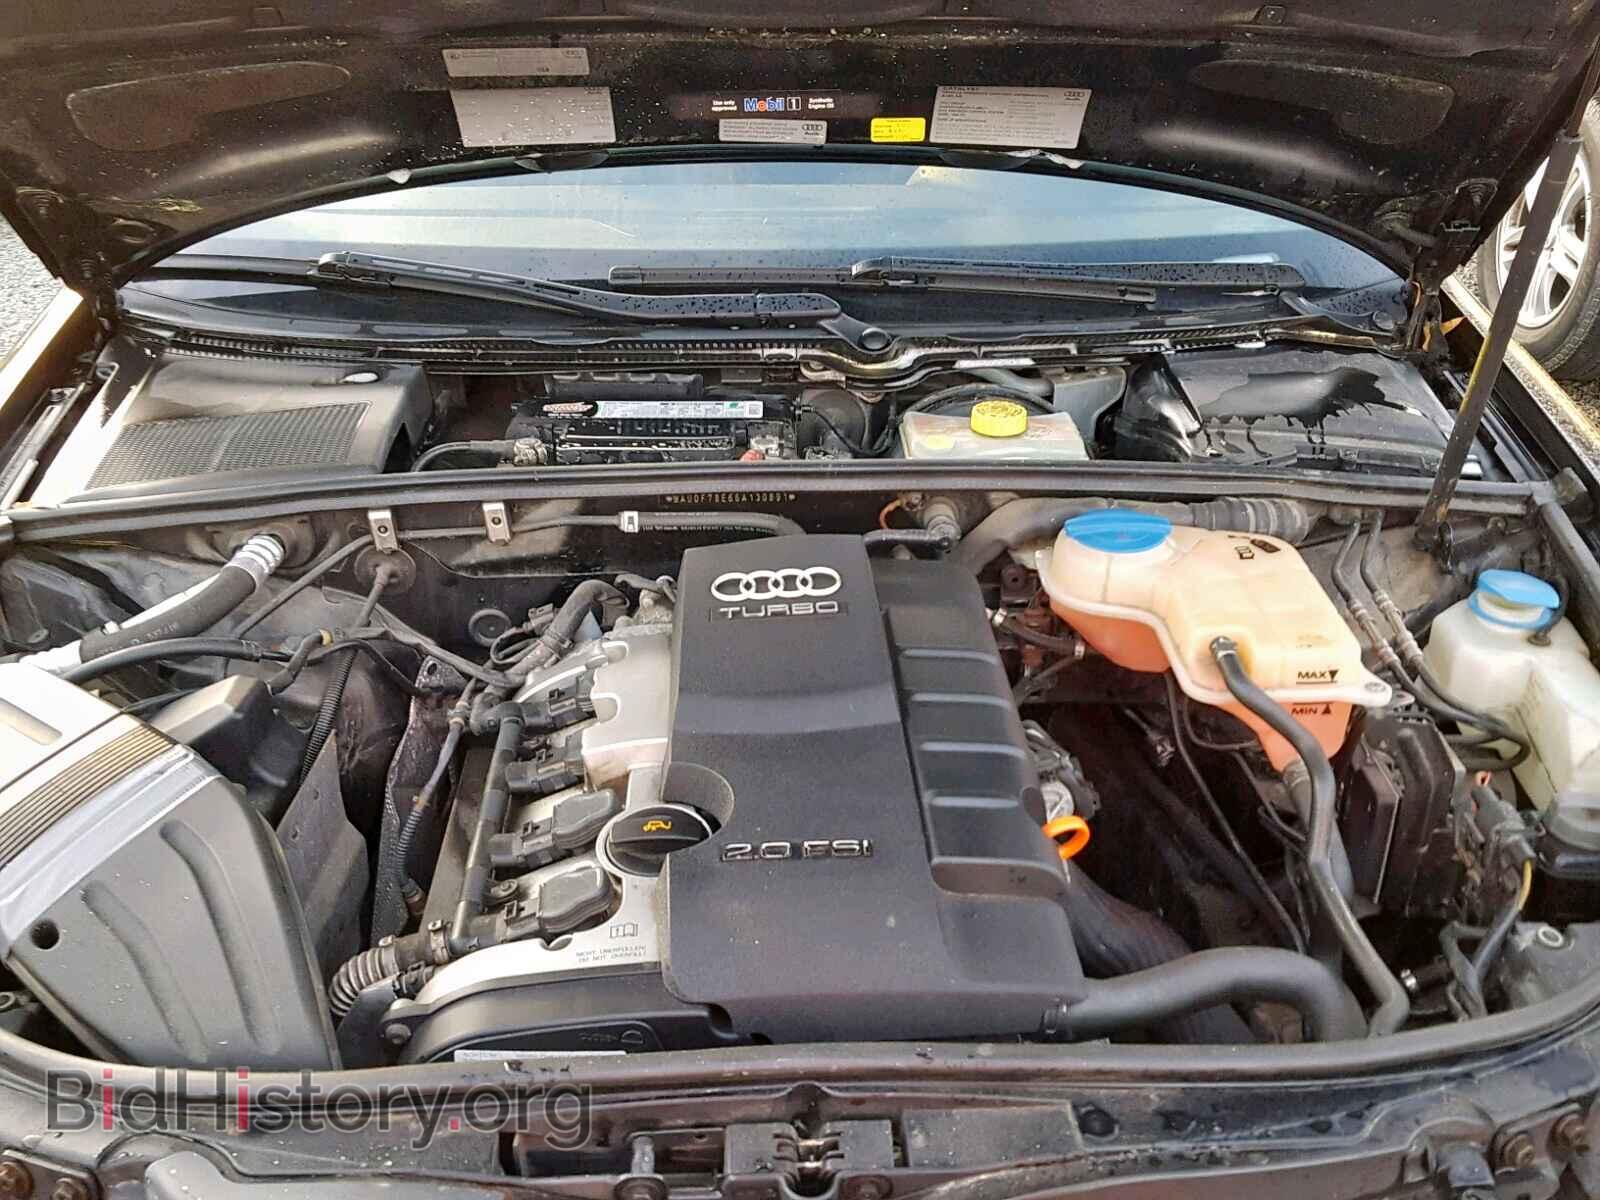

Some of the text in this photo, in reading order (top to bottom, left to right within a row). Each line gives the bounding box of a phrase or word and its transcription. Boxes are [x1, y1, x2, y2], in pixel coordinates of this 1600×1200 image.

[743, 97, 785, 112] Mobil
[719, 600, 839, 619] TURBO
[1297, 671, 1327, 680] MAX
[1291, 707, 1318, 715] MIN
[721, 838, 873, 861] 2.0 FSI
